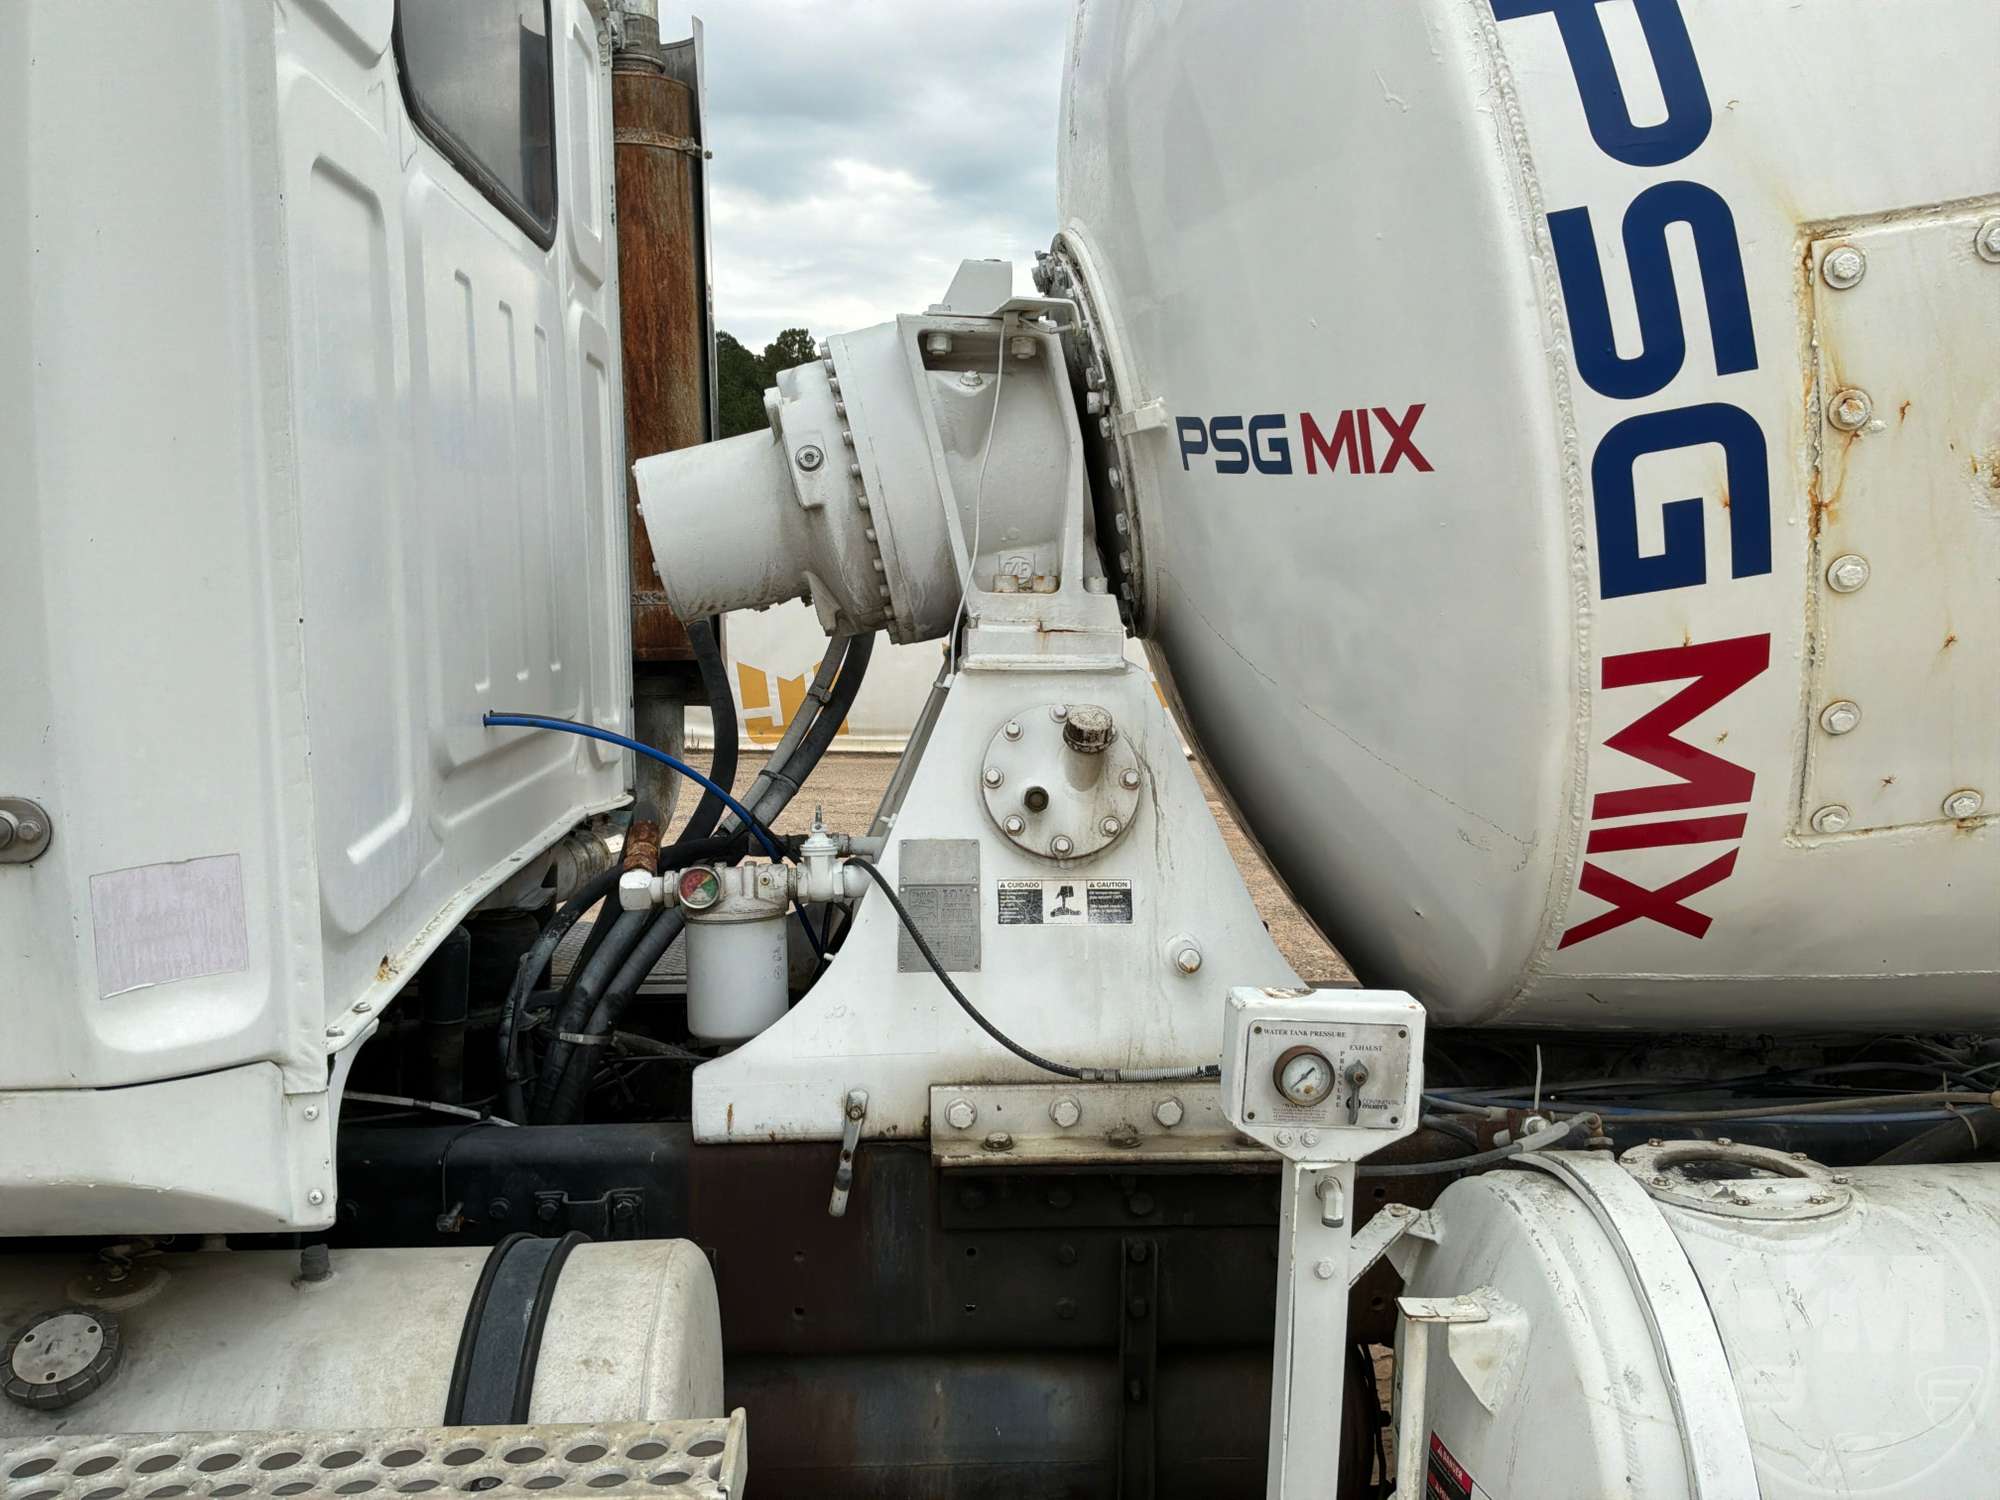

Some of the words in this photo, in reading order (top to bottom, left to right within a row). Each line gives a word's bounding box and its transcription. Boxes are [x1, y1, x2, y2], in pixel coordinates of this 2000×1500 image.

[1489, 0, 1772, 600] PSG
[1175, 413, 1293, 475] PSG
[1299, 403, 1435, 475] MIX
[1557, 633, 1771, 951] MIX
[1007, 881, 1040, 889] CUIDADO
[1096, 881, 1128, 889] CAUTION
[1263, 1028, 1288, 1036] WATER
[1290, 1029, 1308, 1037] TANK
[1310, 1030, 1347, 1038] PRESSURE
